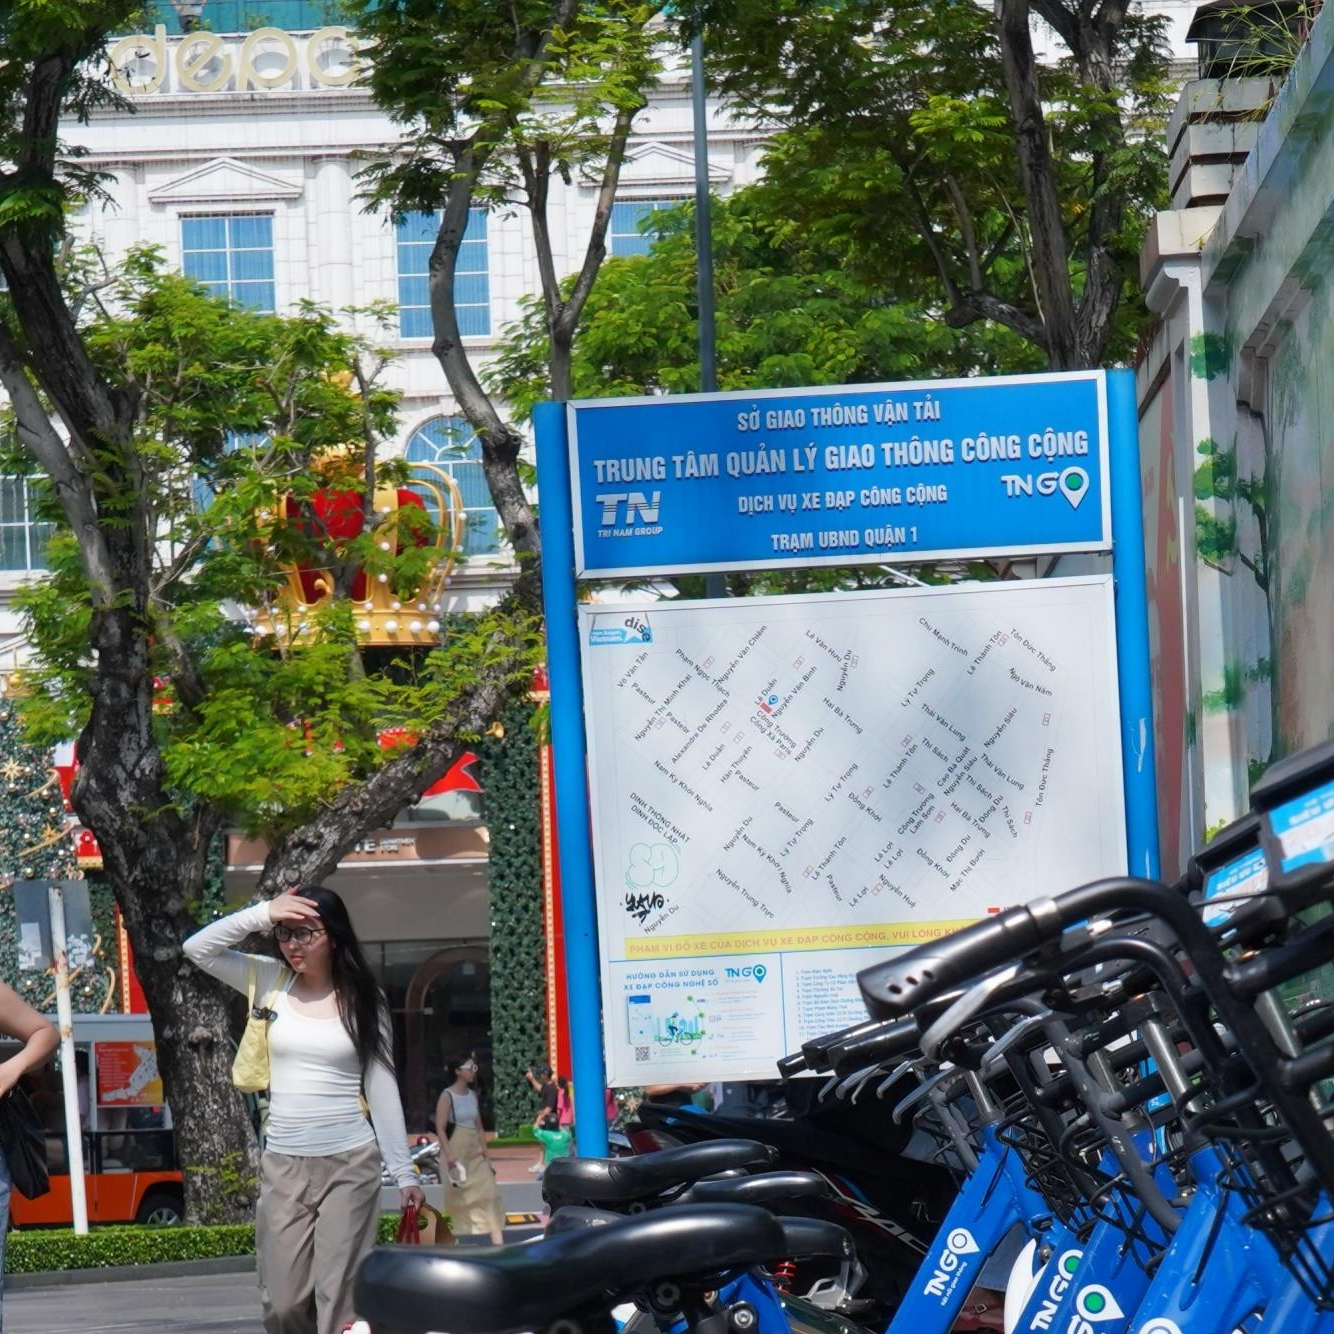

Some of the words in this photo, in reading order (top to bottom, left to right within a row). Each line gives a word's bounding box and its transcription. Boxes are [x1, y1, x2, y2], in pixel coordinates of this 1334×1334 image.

[738, 404, 760, 431] SỞ
[767, 409, 805, 430] GIAO
[811, 402, 867, 427] THÔNG
[873, 399, 908, 426] VẬN
[913, 394, 941, 420] TẢI
[594, 456, 666, 483] TRUNG
[672, 450, 719, 479] TÂM
[727, 442, 786, 477] QUẢN
[792, 442, 817, 472] LÝ
[825, 443, 875, 470] GIAO
[882, 435, 954, 466] THÔNG
[961, 432, 1021, 463] CÔNG
[1028, 427, 1088, 463] CỘNG
[595, 491, 661, 526] TN
[738, 495, 773, 516] DỊCH
[778, 493, 797, 514] VỤ
[802, 492, 821, 510] XE
[825, 491, 855, 512] ĐẠP
[861, 486, 901, 507] CÔNG
[906, 482, 948, 507] CỘNG
[613, 528, 633, 537] NAM
[635, 526, 663, 536] GROUP
[771, 532, 814, 553] TRẠM
[818, 529, 859, 549] UBND
[864, 524, 906, 548] QUẬN
[910, 526, 918, 543] 1
[705, 699, 728, 723] Rhodes
[735, 770, 760, 792] Pasteur
[774, 801, 799, 823] Pasteur
